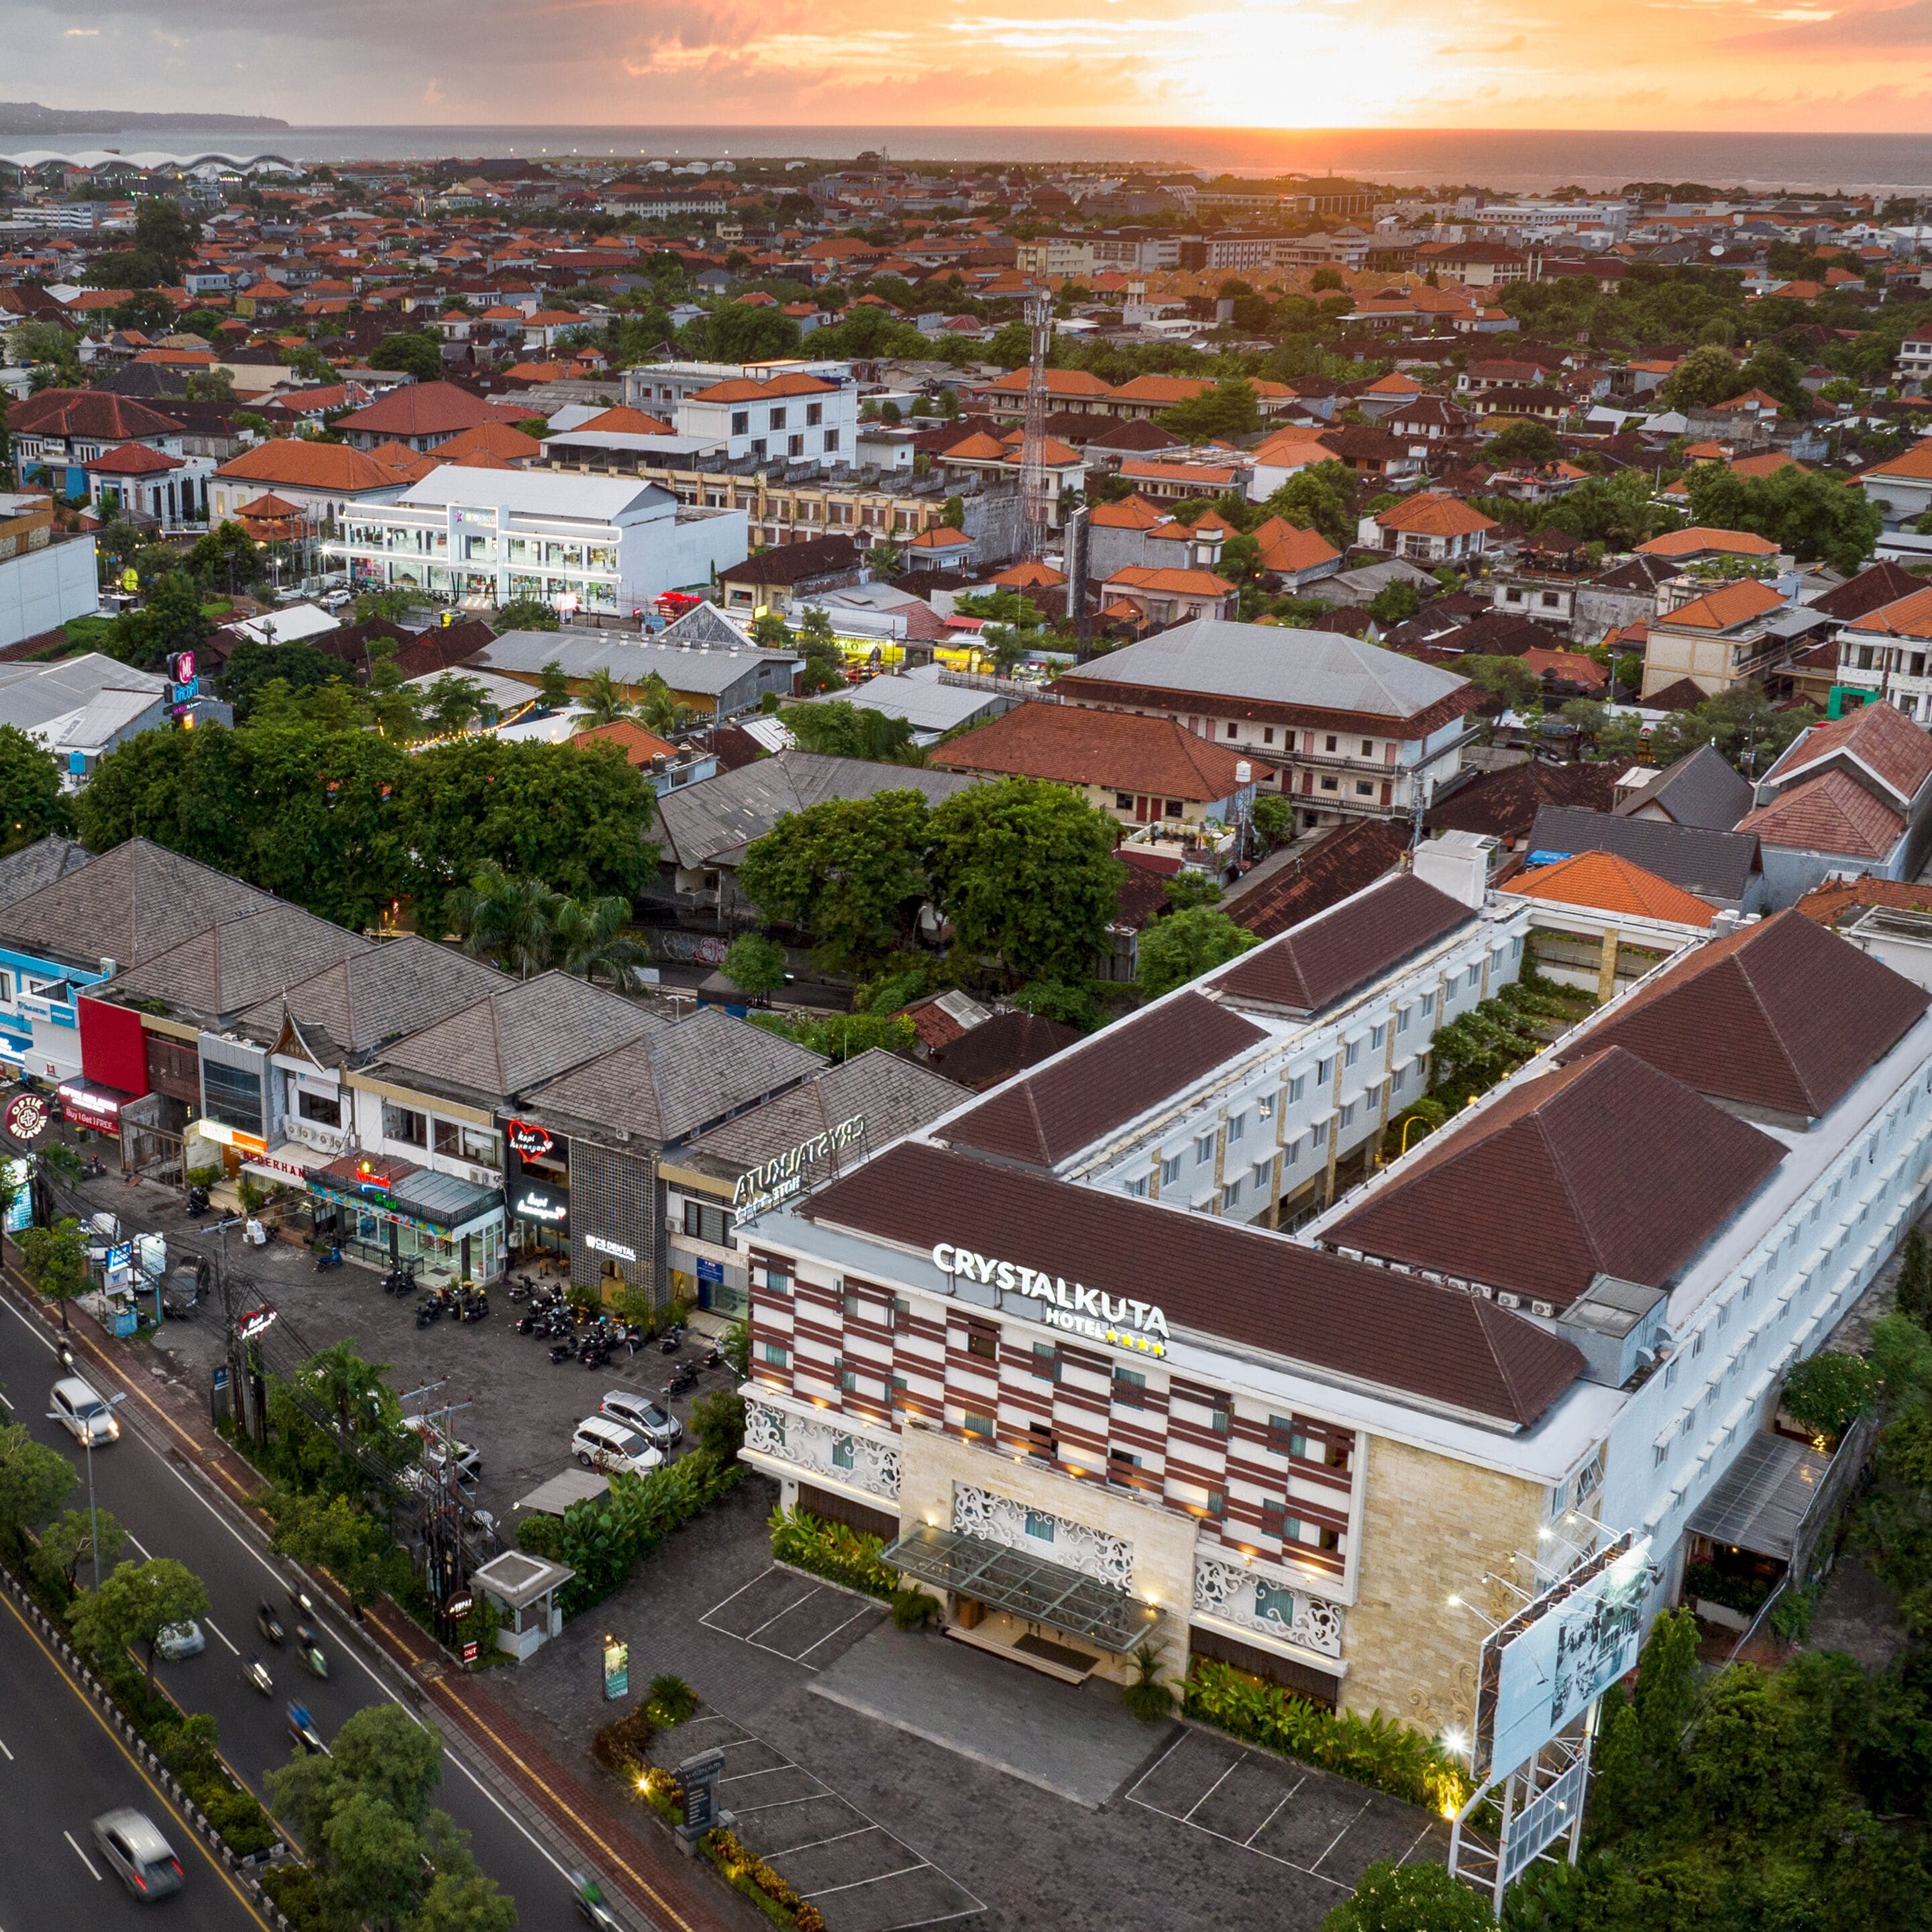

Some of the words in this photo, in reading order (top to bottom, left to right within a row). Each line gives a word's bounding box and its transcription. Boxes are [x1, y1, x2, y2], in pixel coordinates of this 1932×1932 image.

[11, 1097, 44, 1115] OPTIK
[10, 1116, 48, 1138] MELAWAI
[66, 1108, 78, 1120] Buy
[97, 1118, 113, 1128] FREE
[607, 1241, 636, 1258] DENTAL
[932, 1243, 1170, 1338] CRYSTALKUTA
[1046, 1307, 1106, 1339] HOTEL
[464, 1647, 477, 1656] OUT
